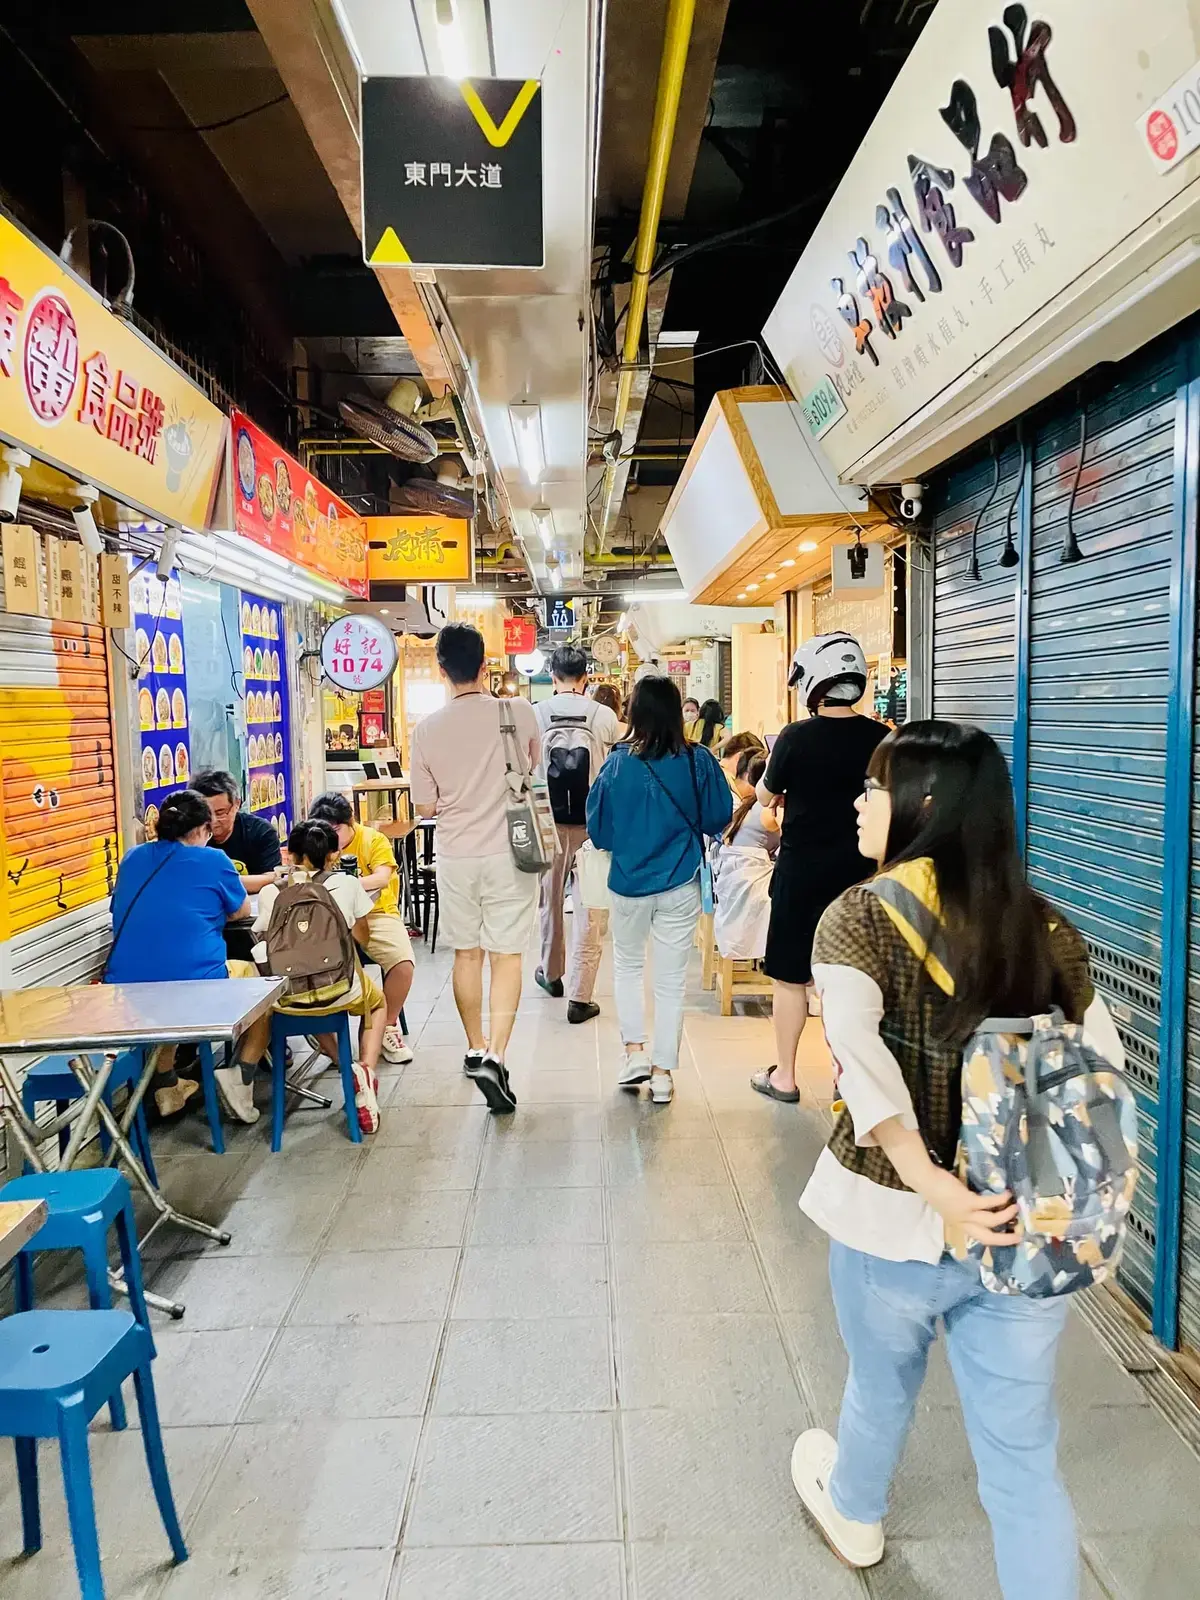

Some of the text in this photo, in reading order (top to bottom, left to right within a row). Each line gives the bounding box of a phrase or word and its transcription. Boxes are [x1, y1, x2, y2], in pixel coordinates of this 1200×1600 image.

[1172, 74, 1200, 136] 10
[403, 161, 503, 188] 東門大道
[77, 350, 166, 466] 食品號
[111, 574, 122, 613] 甜不辣
[333, 637, 381, 656] 好記
[332, 658, 384, 673] 1074
